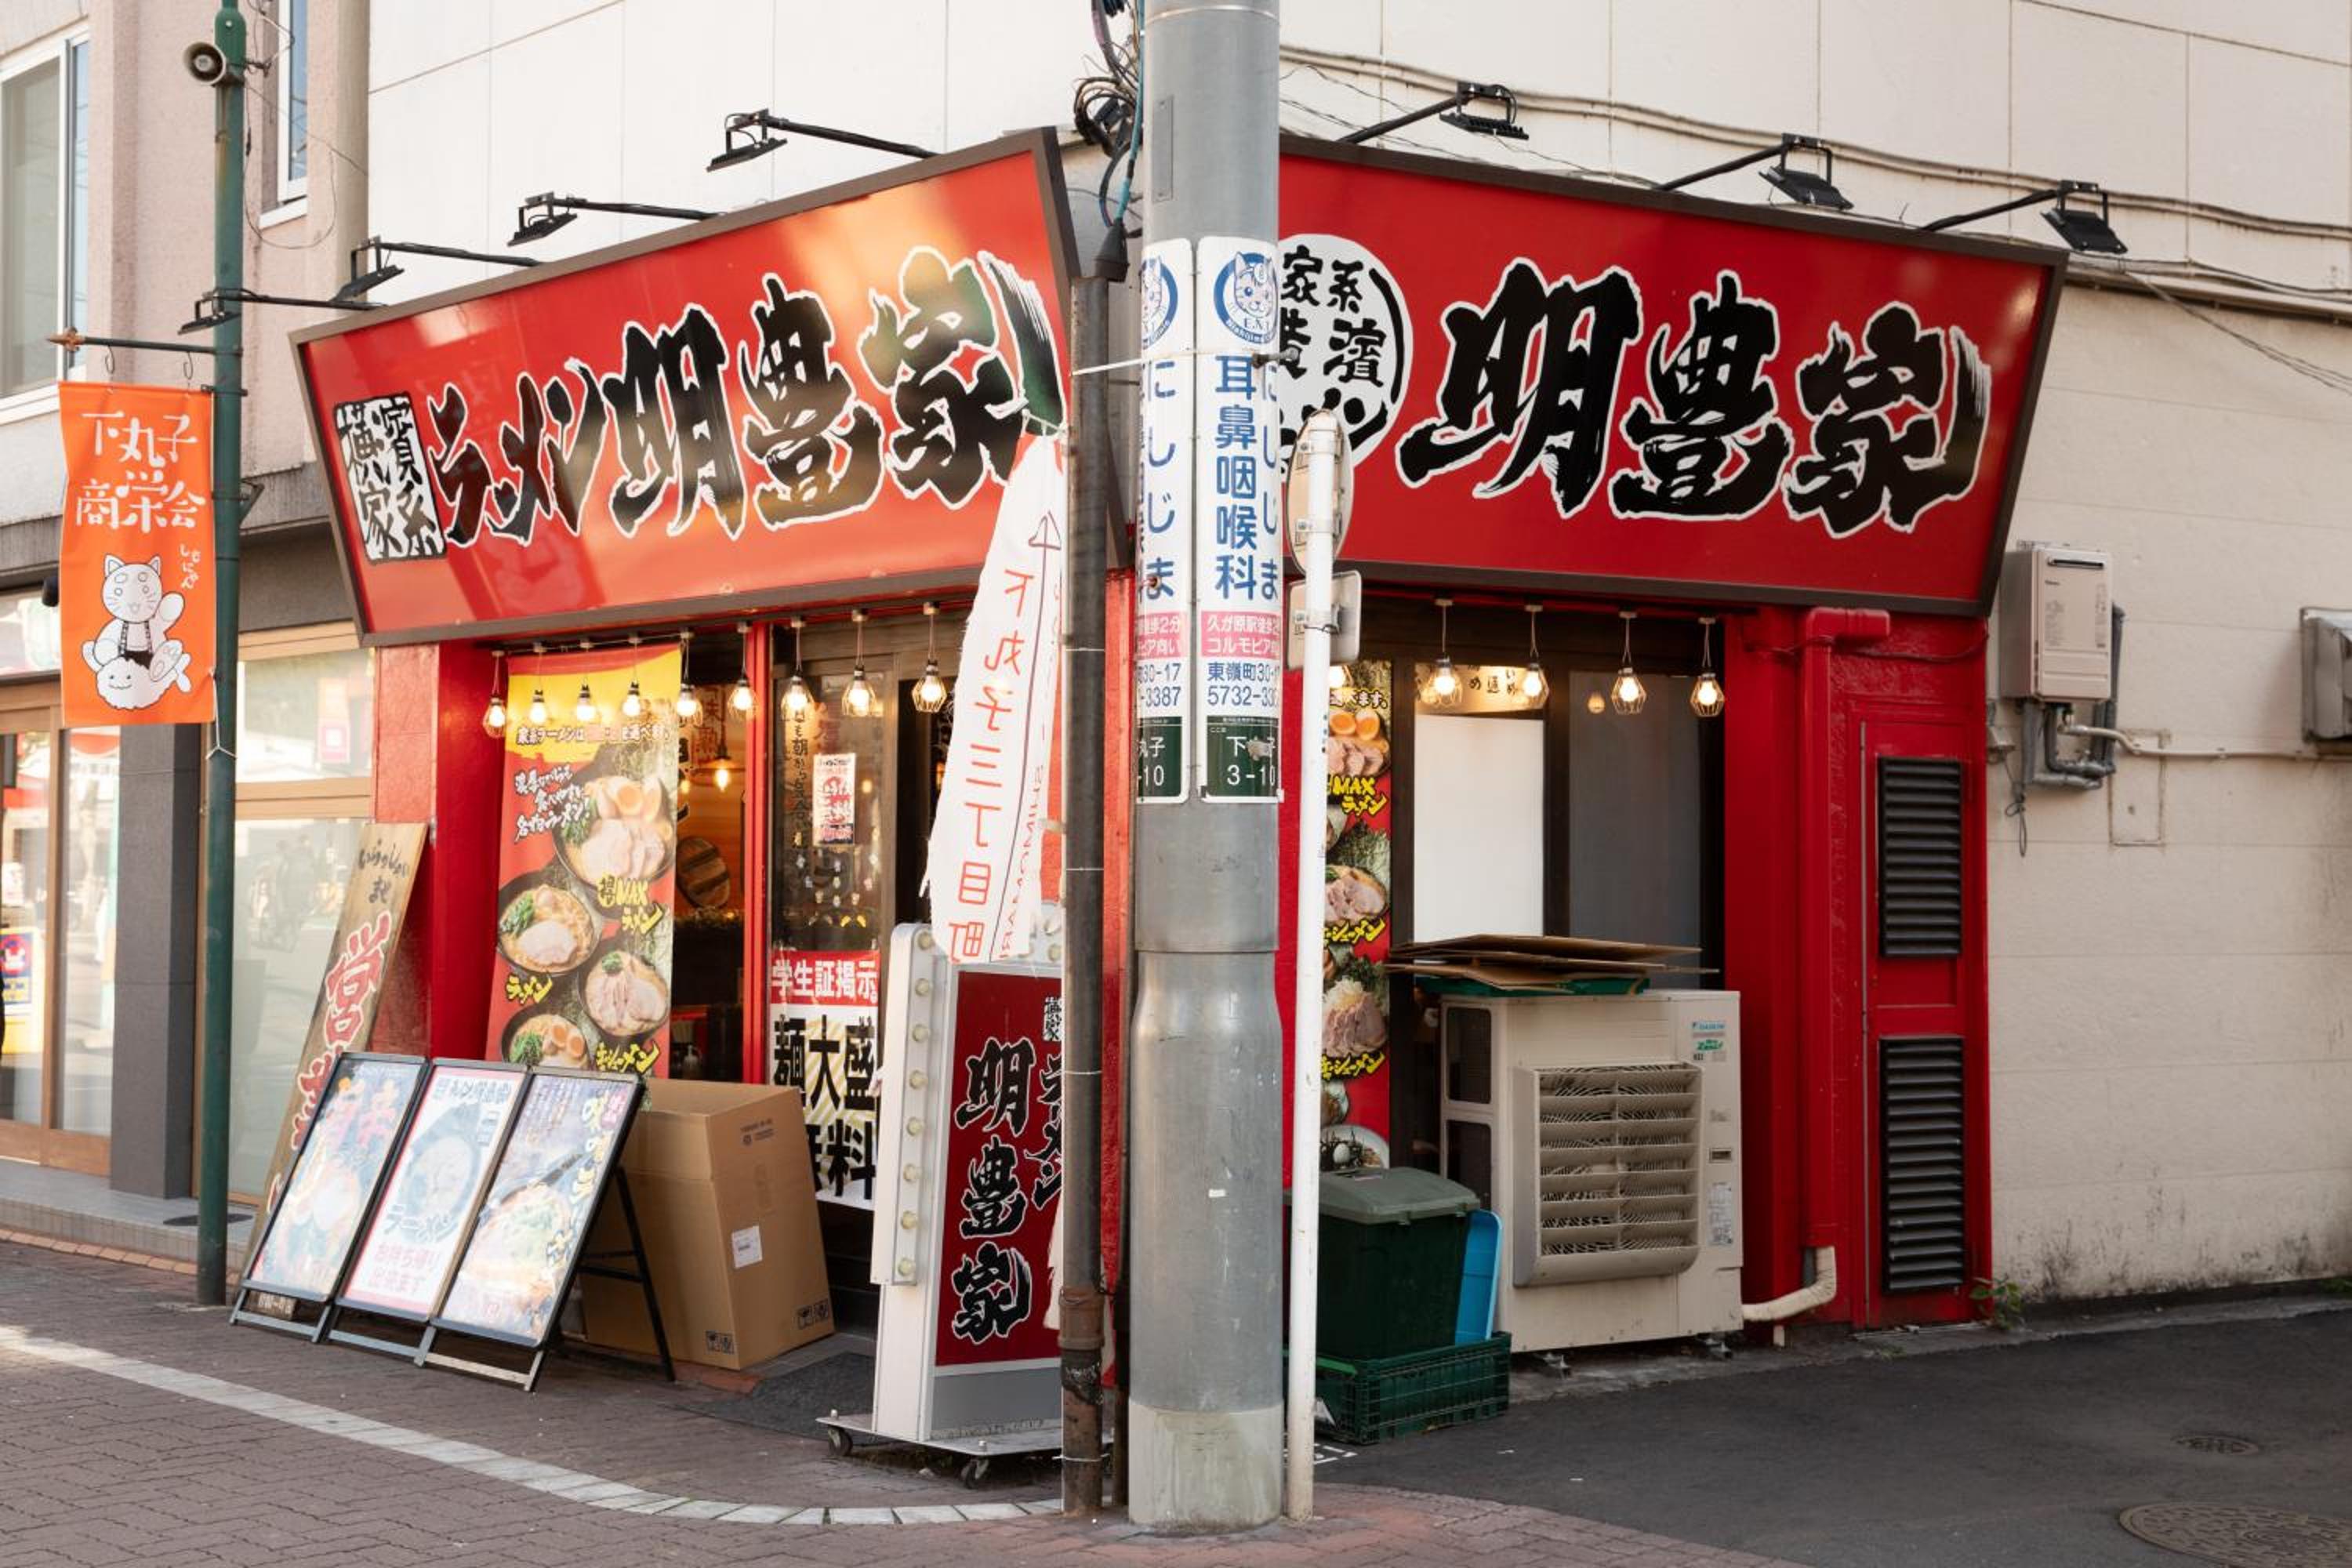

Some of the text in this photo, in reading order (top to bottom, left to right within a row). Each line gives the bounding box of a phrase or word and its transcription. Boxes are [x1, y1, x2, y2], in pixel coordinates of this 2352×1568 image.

[1280, 245, 1363, 314] 家系
[82, 410, 198, 468] 下丸子
[1396, 256, 1991, 539] 明豊家
[75, 469, 206, 534] 商栄会
[1146, 361, 1177, 601] にしじま
[1214, 355, 1258, 600] 耳鼻咽喉科
[1226, 764, 1276, 786] 3-10
[951, 1036, 1036, 1345] 明豊家
